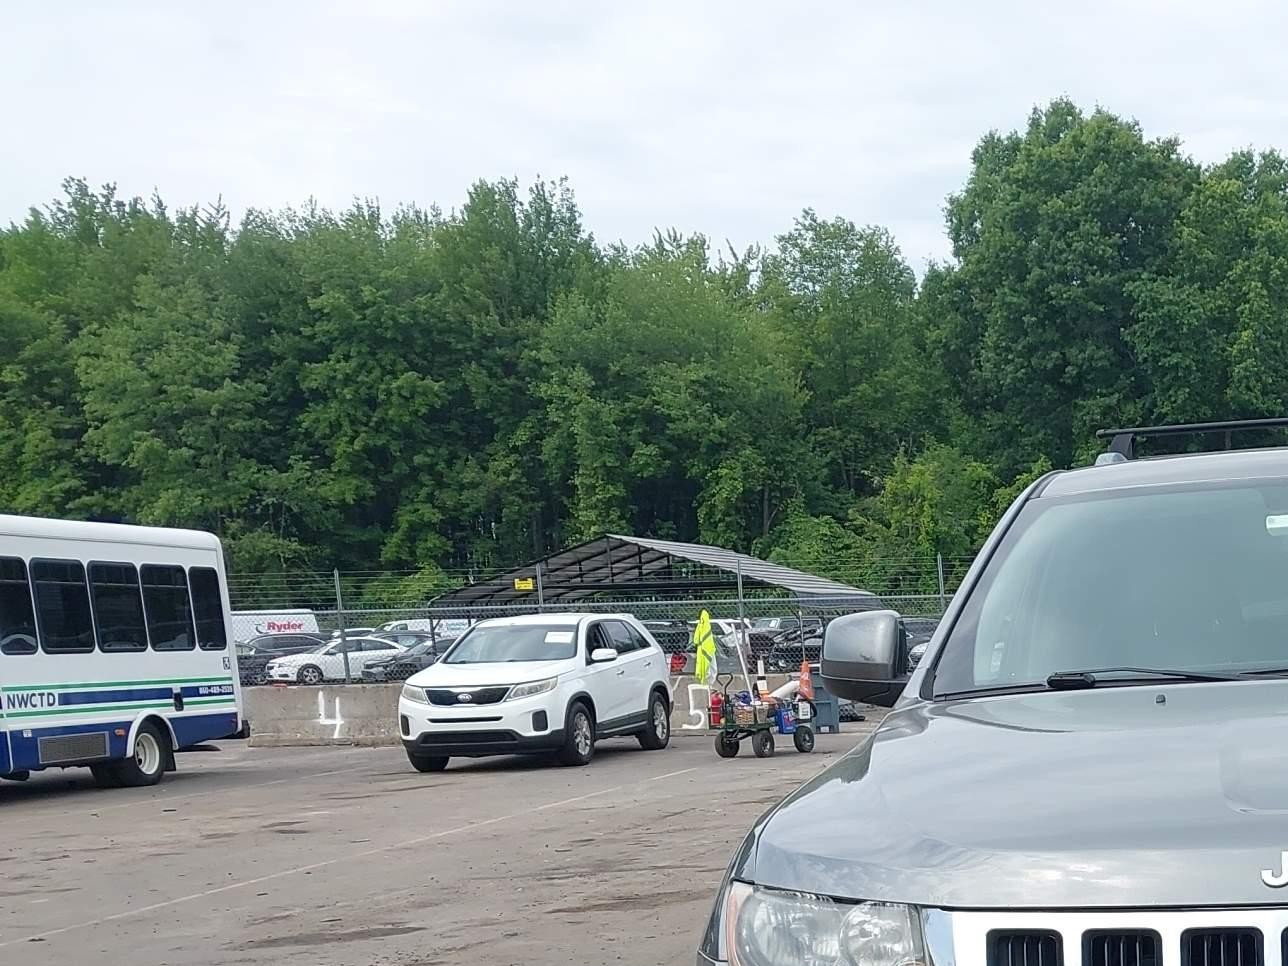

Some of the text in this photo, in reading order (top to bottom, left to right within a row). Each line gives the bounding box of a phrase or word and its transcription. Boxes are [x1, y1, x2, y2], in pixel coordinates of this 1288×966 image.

[267, 621, 304, 633] Ryder
[7, 692, 56, 709] NWCTD
[312, 690, 345, 739] 4
[682, 684, 710, 729] 5
